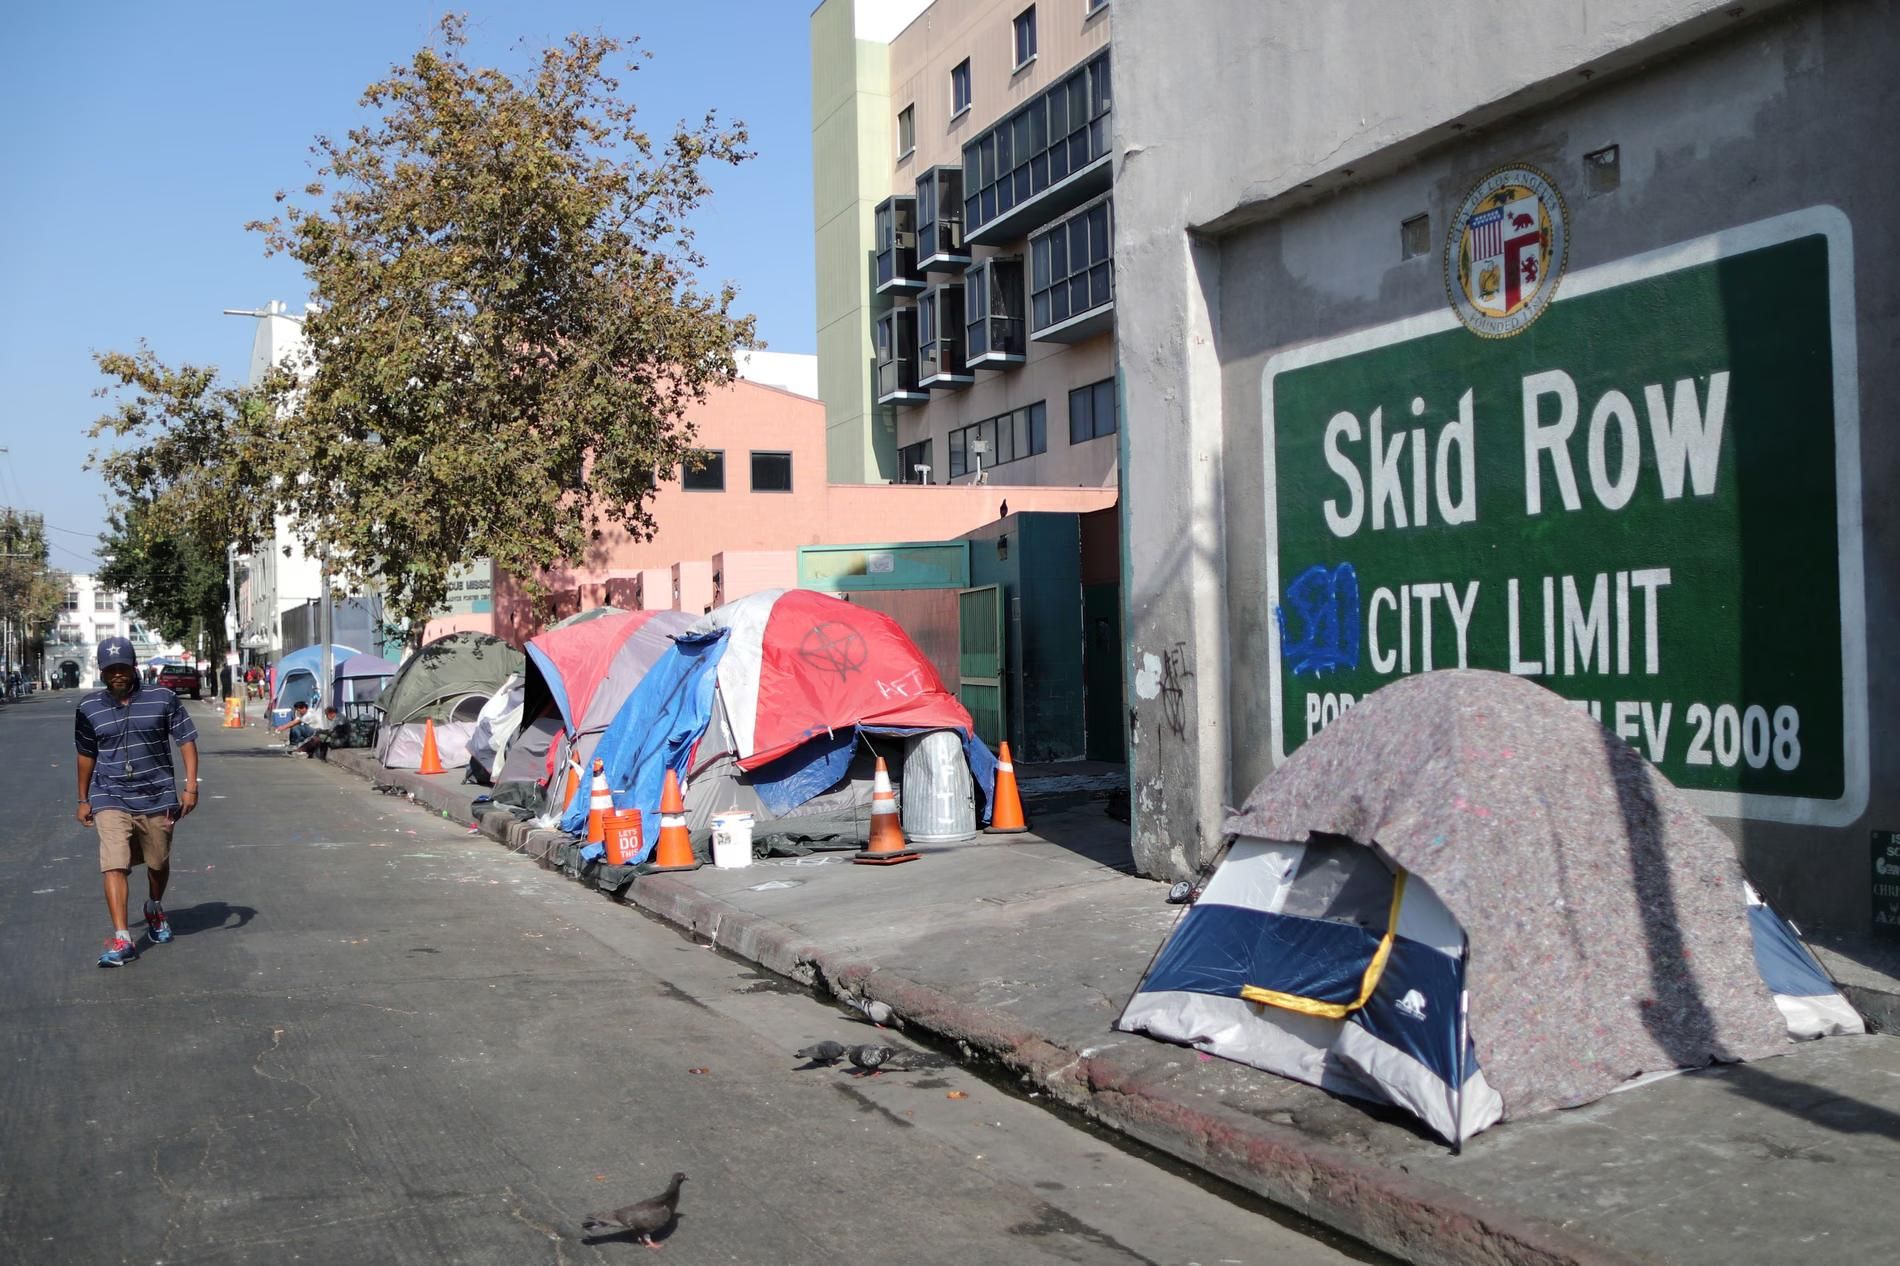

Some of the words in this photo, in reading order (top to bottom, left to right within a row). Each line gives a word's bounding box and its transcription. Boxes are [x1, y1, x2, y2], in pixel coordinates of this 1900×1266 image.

[1453, 209, 1471, 244] CITY
[1488, 173, 1511, 191] LOS
[1514, 173, 1559, 212] ANGELES
[1468, 314, 1520, 333] FOUNDED
[1323, 386, 1477, 538] Skid
[1368, 580, 1480, 675] CITY
[1507, 567, 1672, 677] LIMIT
[1685, 702, 1801, 772] 2008
[619, 836, 639, 851] DO
[620, 848, 639, 859] THIS
